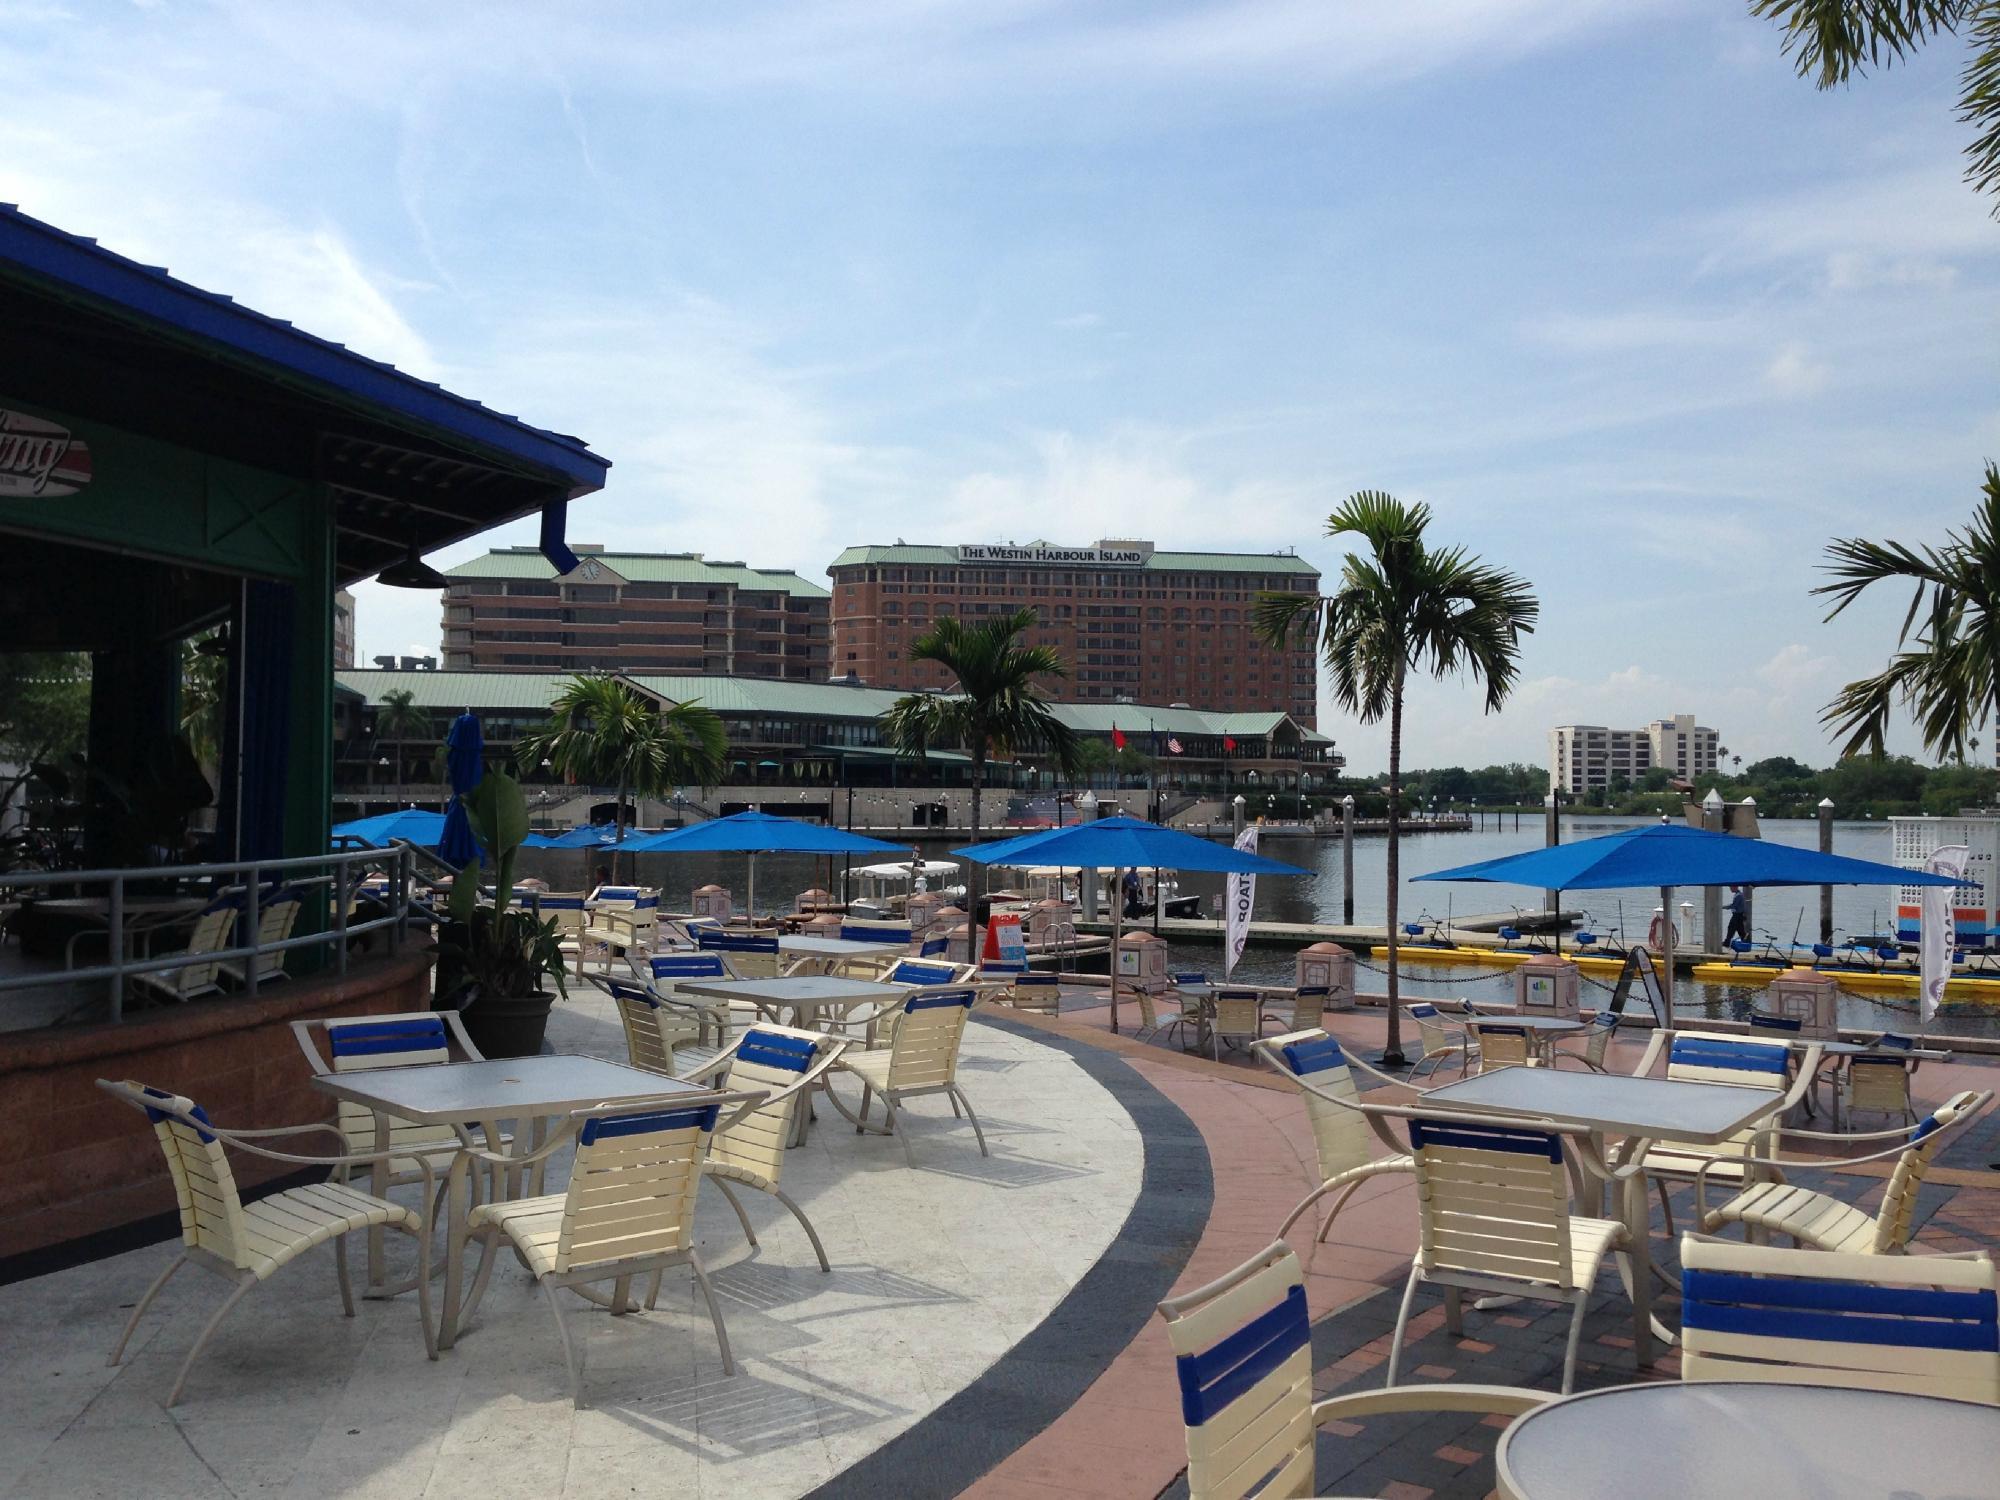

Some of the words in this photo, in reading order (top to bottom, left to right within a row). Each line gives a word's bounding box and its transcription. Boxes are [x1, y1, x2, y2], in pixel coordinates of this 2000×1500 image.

[962, 546, 984, 558] THE
[987, 547, 1032, 560] WESTIN
[1036, 549, 1095, 561] HARBOUR
[1100, 550, 1141, 562] ISLAND
